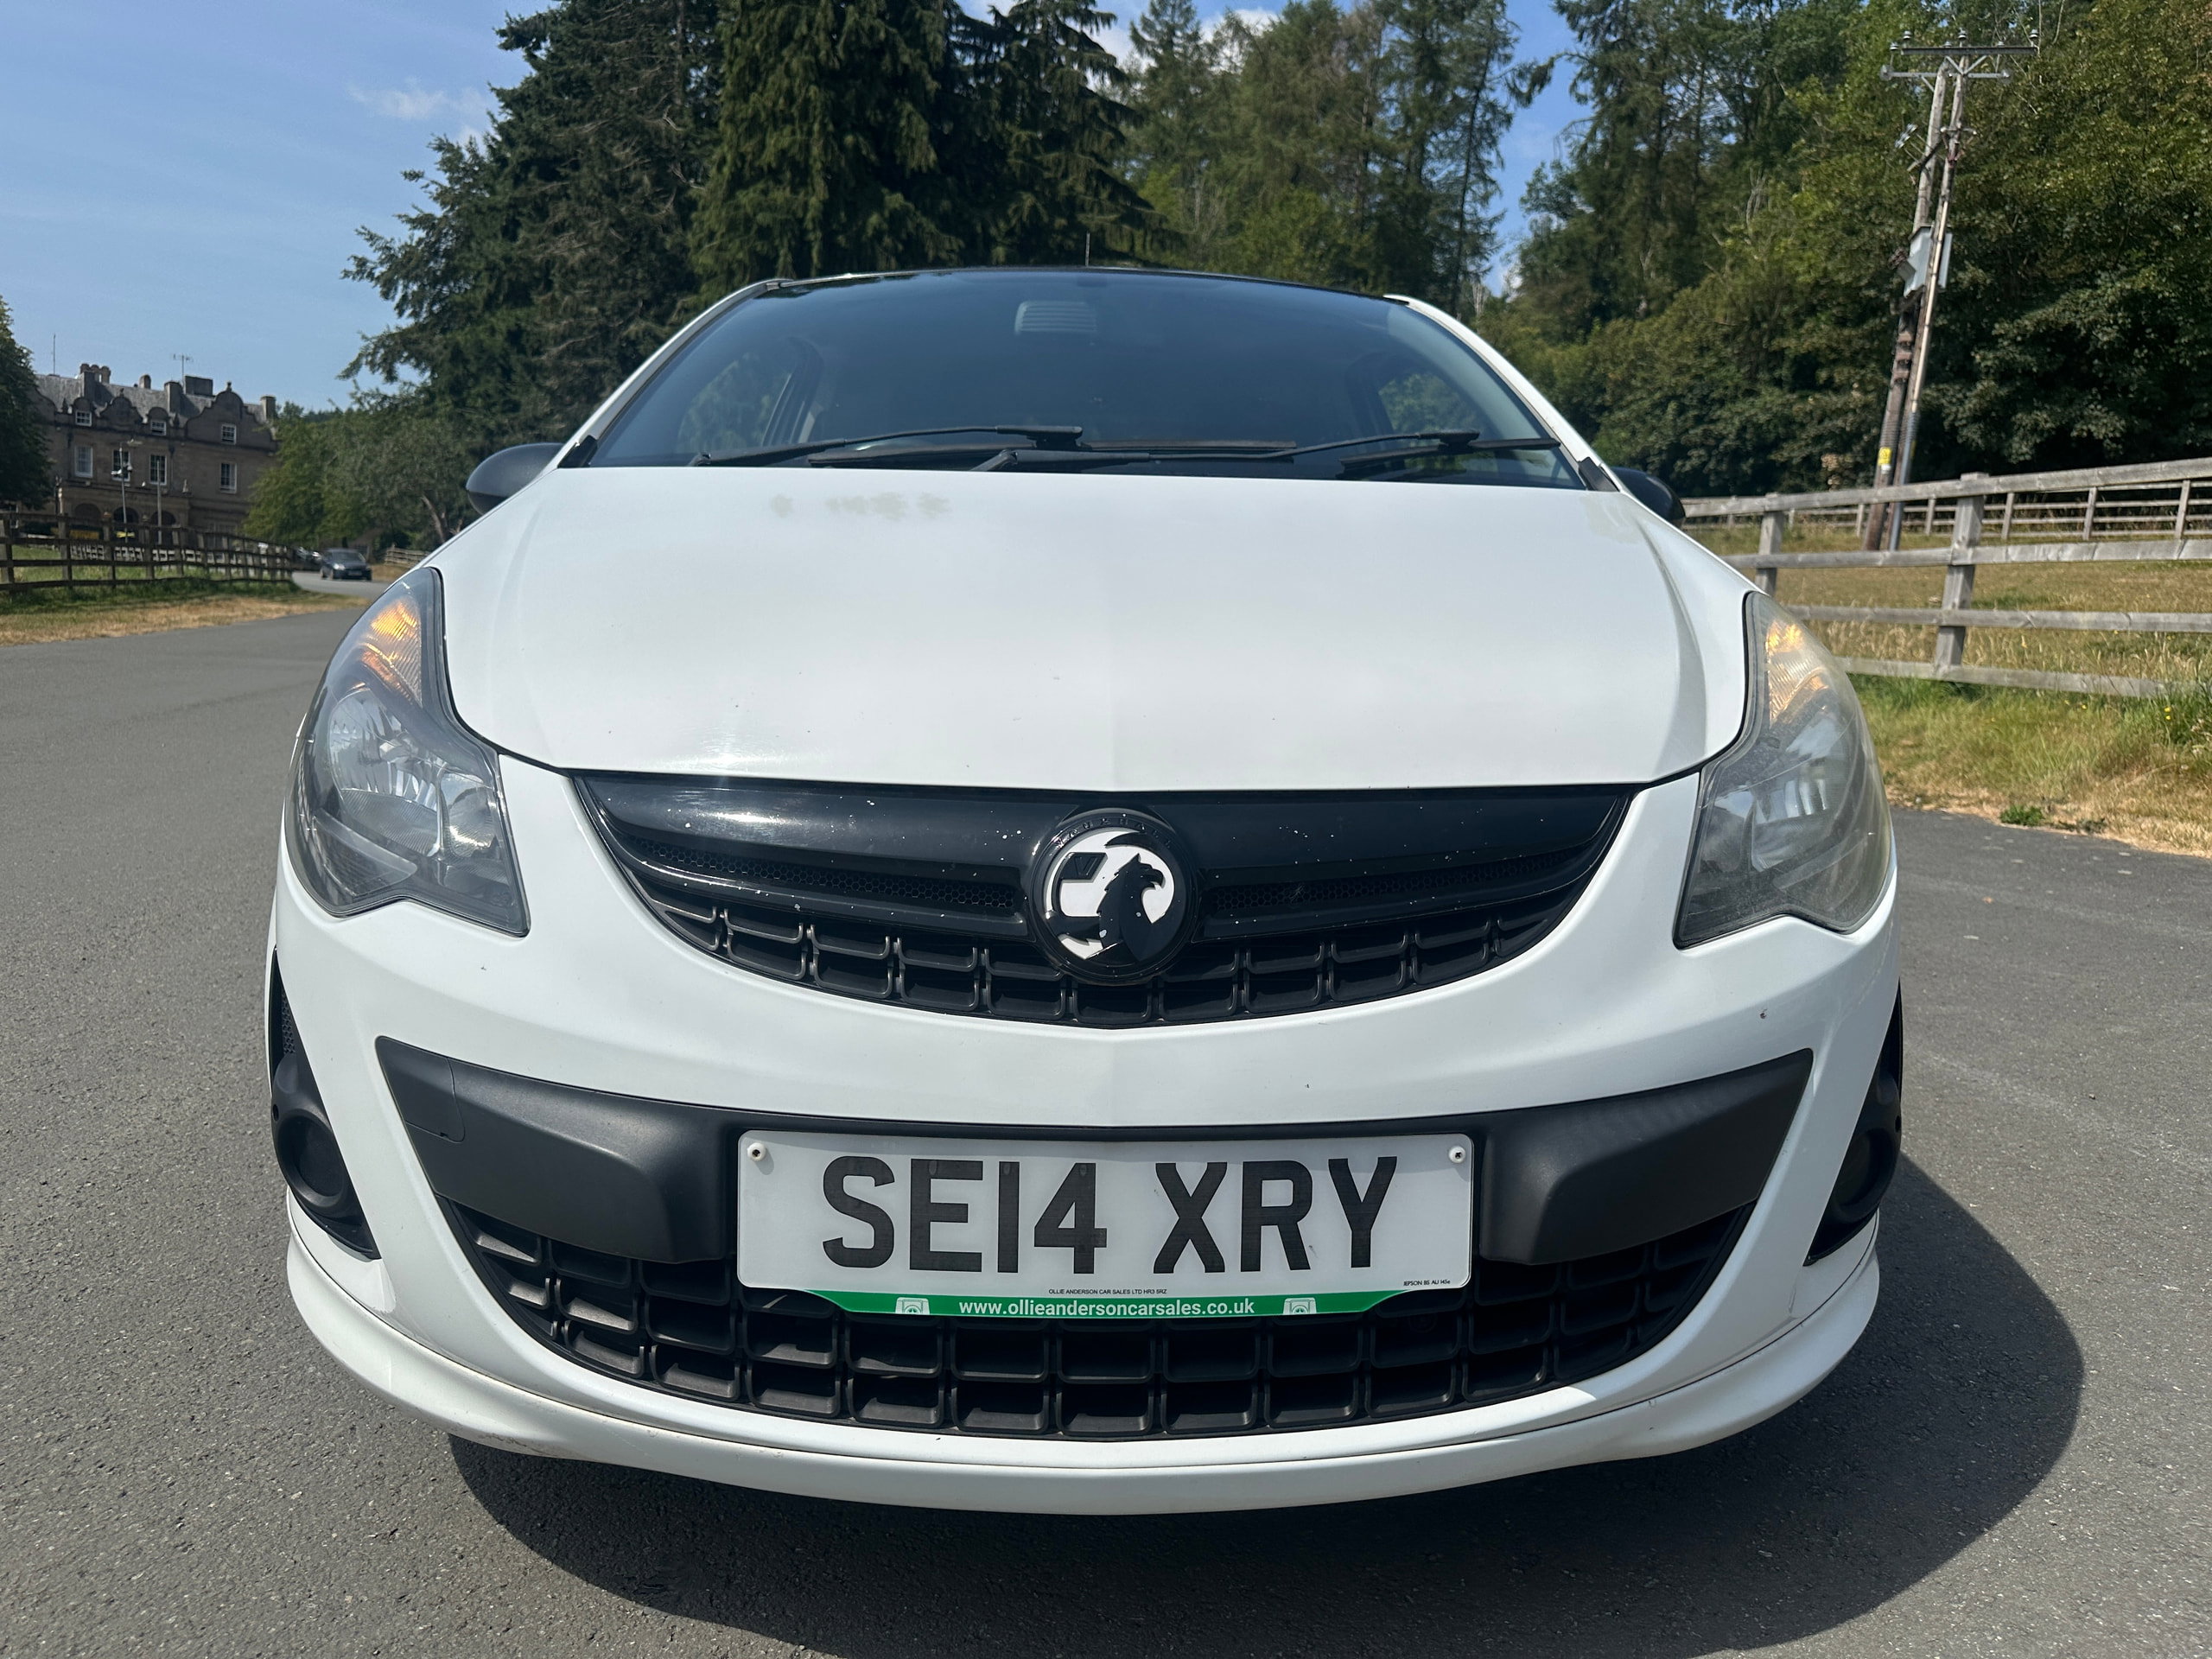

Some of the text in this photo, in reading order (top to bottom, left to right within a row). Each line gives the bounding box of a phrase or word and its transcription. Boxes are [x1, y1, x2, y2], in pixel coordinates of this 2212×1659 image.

[822, 1155, 1397, 1274] SE14 XRY
[958, 1298, 1255, 1315] www.ollieandersoncarsales.co.uk
